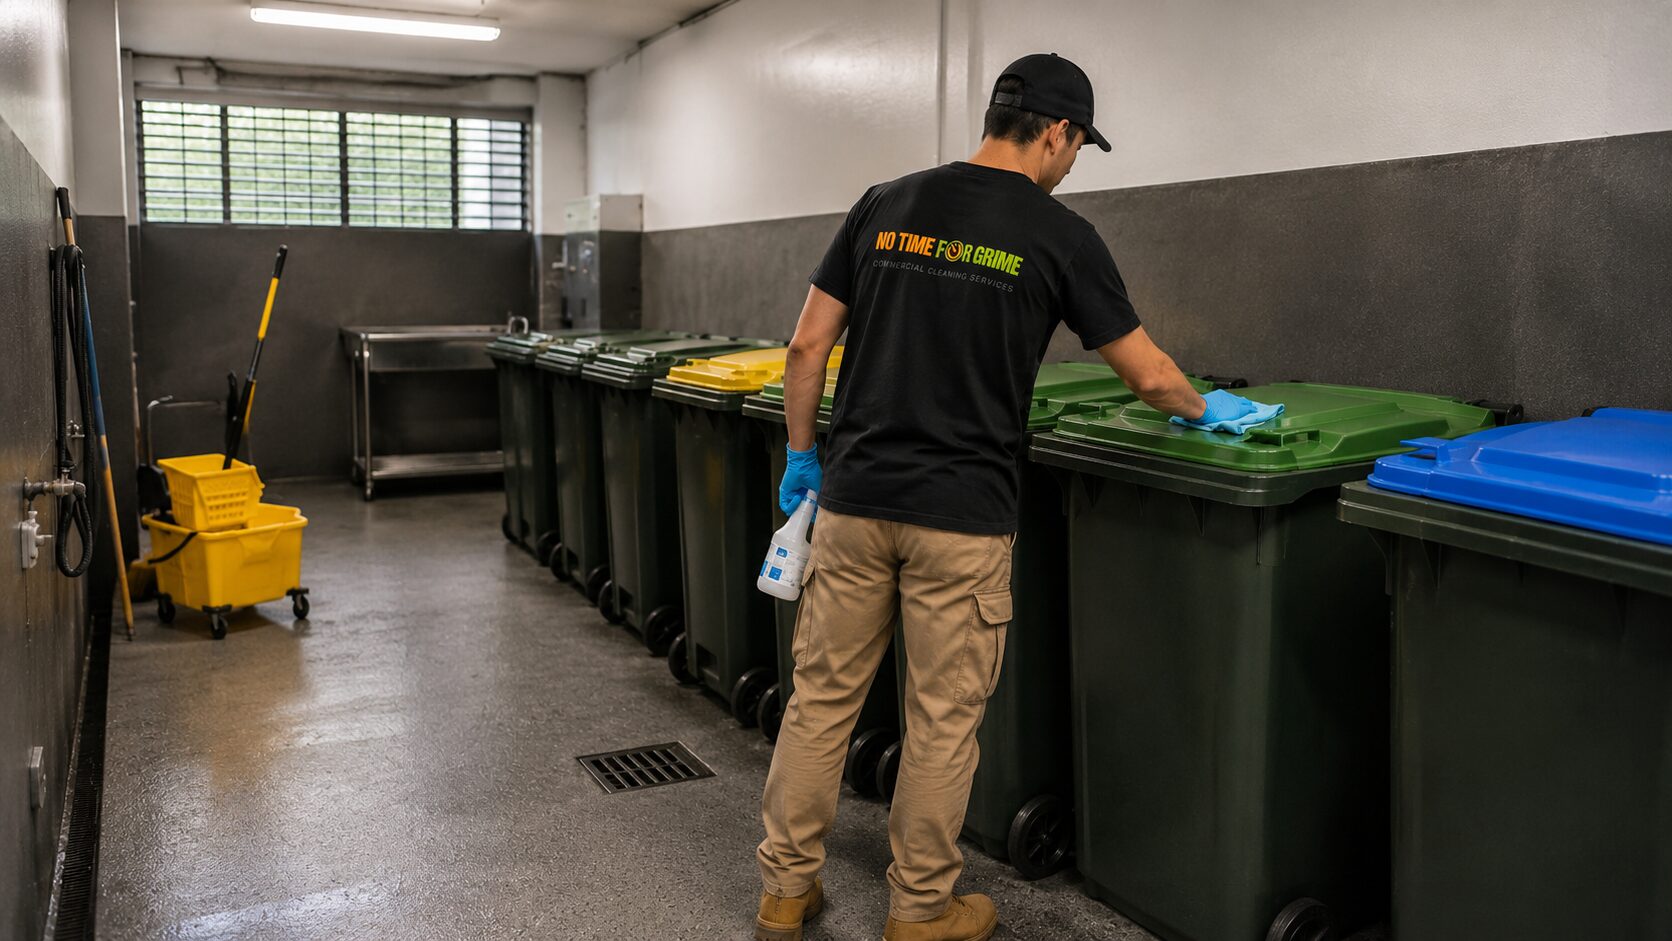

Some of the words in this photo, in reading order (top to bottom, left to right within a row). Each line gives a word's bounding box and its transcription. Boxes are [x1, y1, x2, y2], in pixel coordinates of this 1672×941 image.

[876, 231, 896, 250] NO
[898, 232, 936, 256] TIME
[973, 246, 1024, 276] GRIME
[969, 274, 1014, 292] SERVICES
